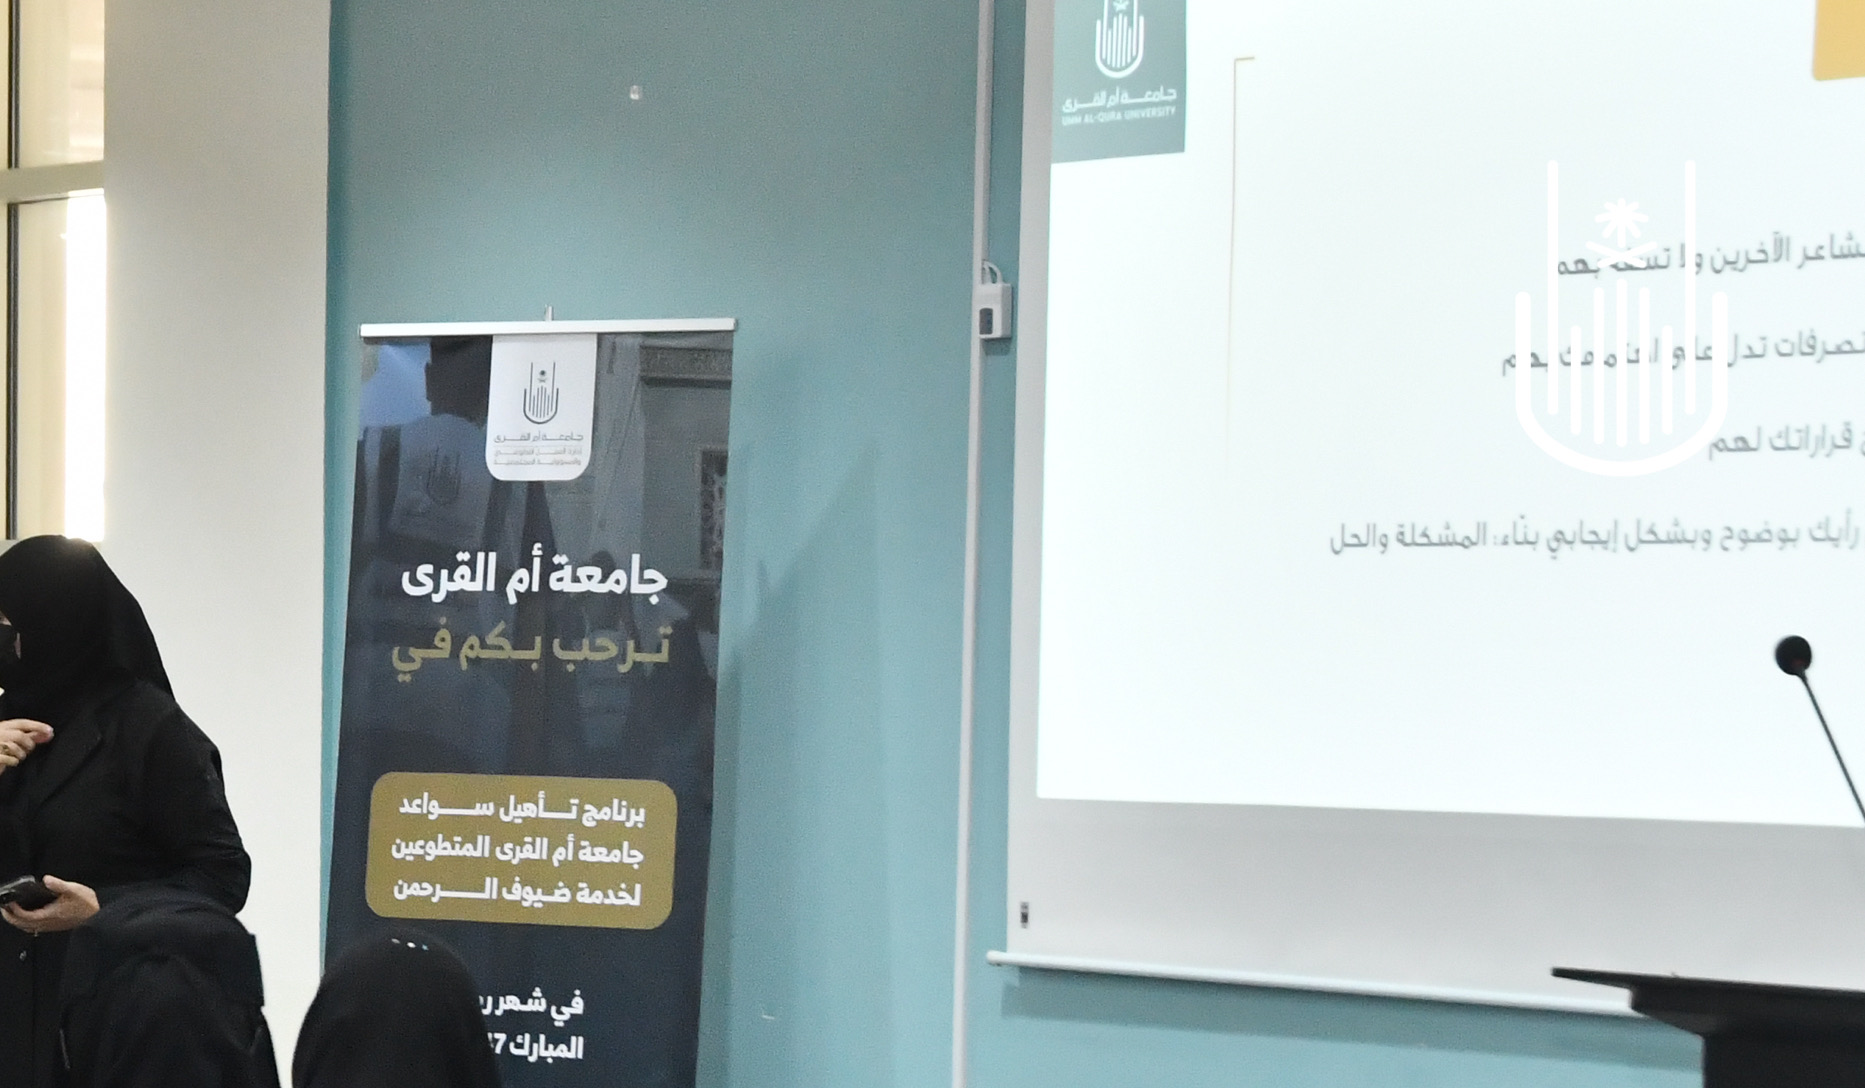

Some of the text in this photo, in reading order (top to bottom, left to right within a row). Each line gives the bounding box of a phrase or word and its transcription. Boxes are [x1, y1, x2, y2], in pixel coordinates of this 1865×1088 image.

[1710, 231, 1790, 274] الآخرين
[1796, 231, 1865, 269] شاعر
[1709, 425, 1762, 461] لهم
[1769, 421, 1853, 458] قراراتك
[1330, 522, 1389, 555] والحل
[1396, 520, 1487, 549] المشكلة
[1546, 519, 1618, 560] إيجابي
[1624, 517, 1713, 552] وبشكل
[1720, 520, 1800, 551] بوضوح
[1808, 507, 1860, 551] رأيك
[401, 542, 669, 606] جامعة أم القرى
[391, 616, 674, 683] ترحب بكم في
[398, 790, 646, 828] برنامج تأهيل سواعد
[390, 833, 645, 869] جامعة أم القرى المتطوعين
[393, 876, 641, 909] لخدمة ضيوف الرحمن
[494, 986, 547, 1017] شهر
[550, 989, 585, 1027] في
[509, 1032, 584, 1064] المبارك
